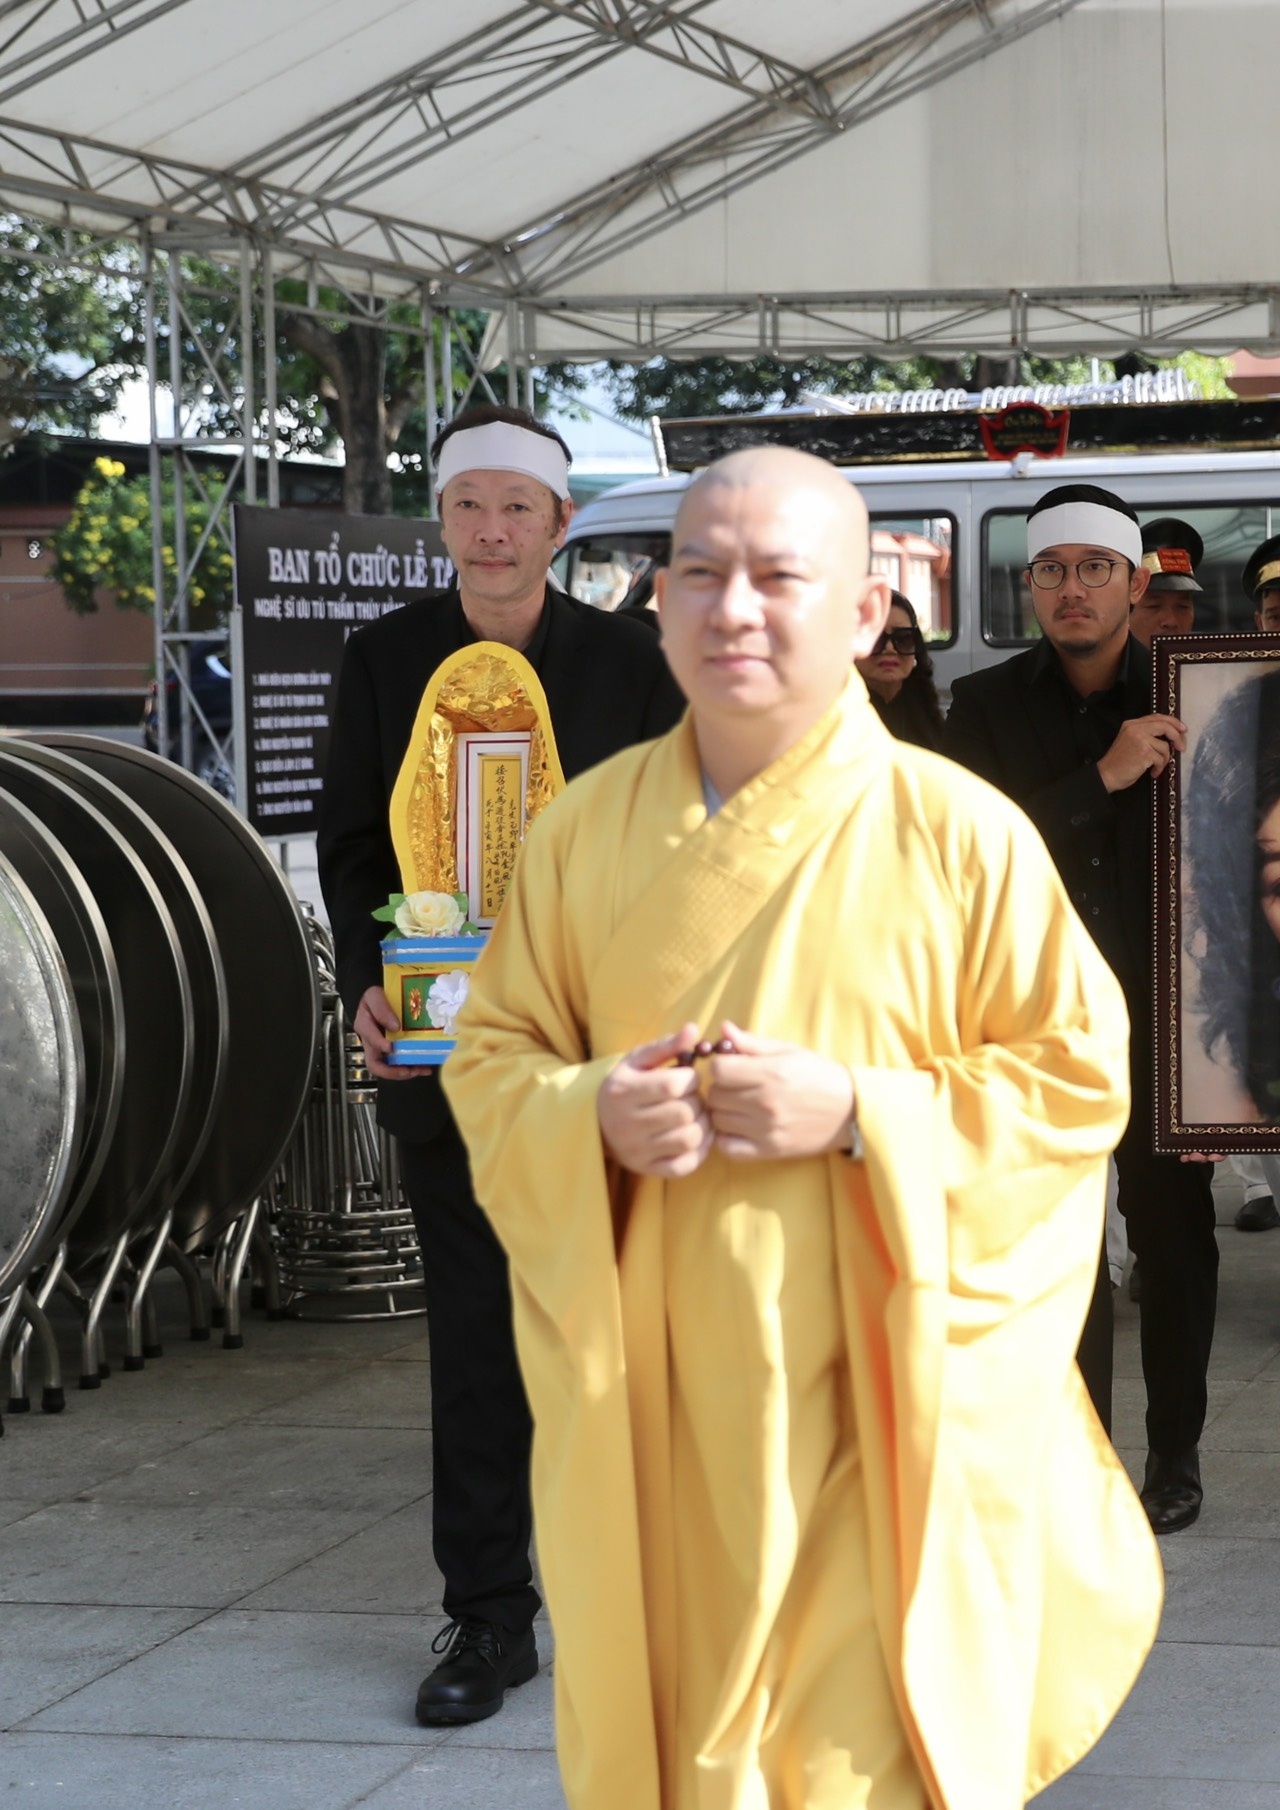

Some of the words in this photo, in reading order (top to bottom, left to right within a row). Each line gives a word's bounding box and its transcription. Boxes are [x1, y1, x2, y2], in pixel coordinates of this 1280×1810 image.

[268, 547, 310, 584] BAN
[314, 531, 342, 586] TỔ
[347, 544, 400, 588] CHỨC
[254, 594, 282, 622] NGHỆ
